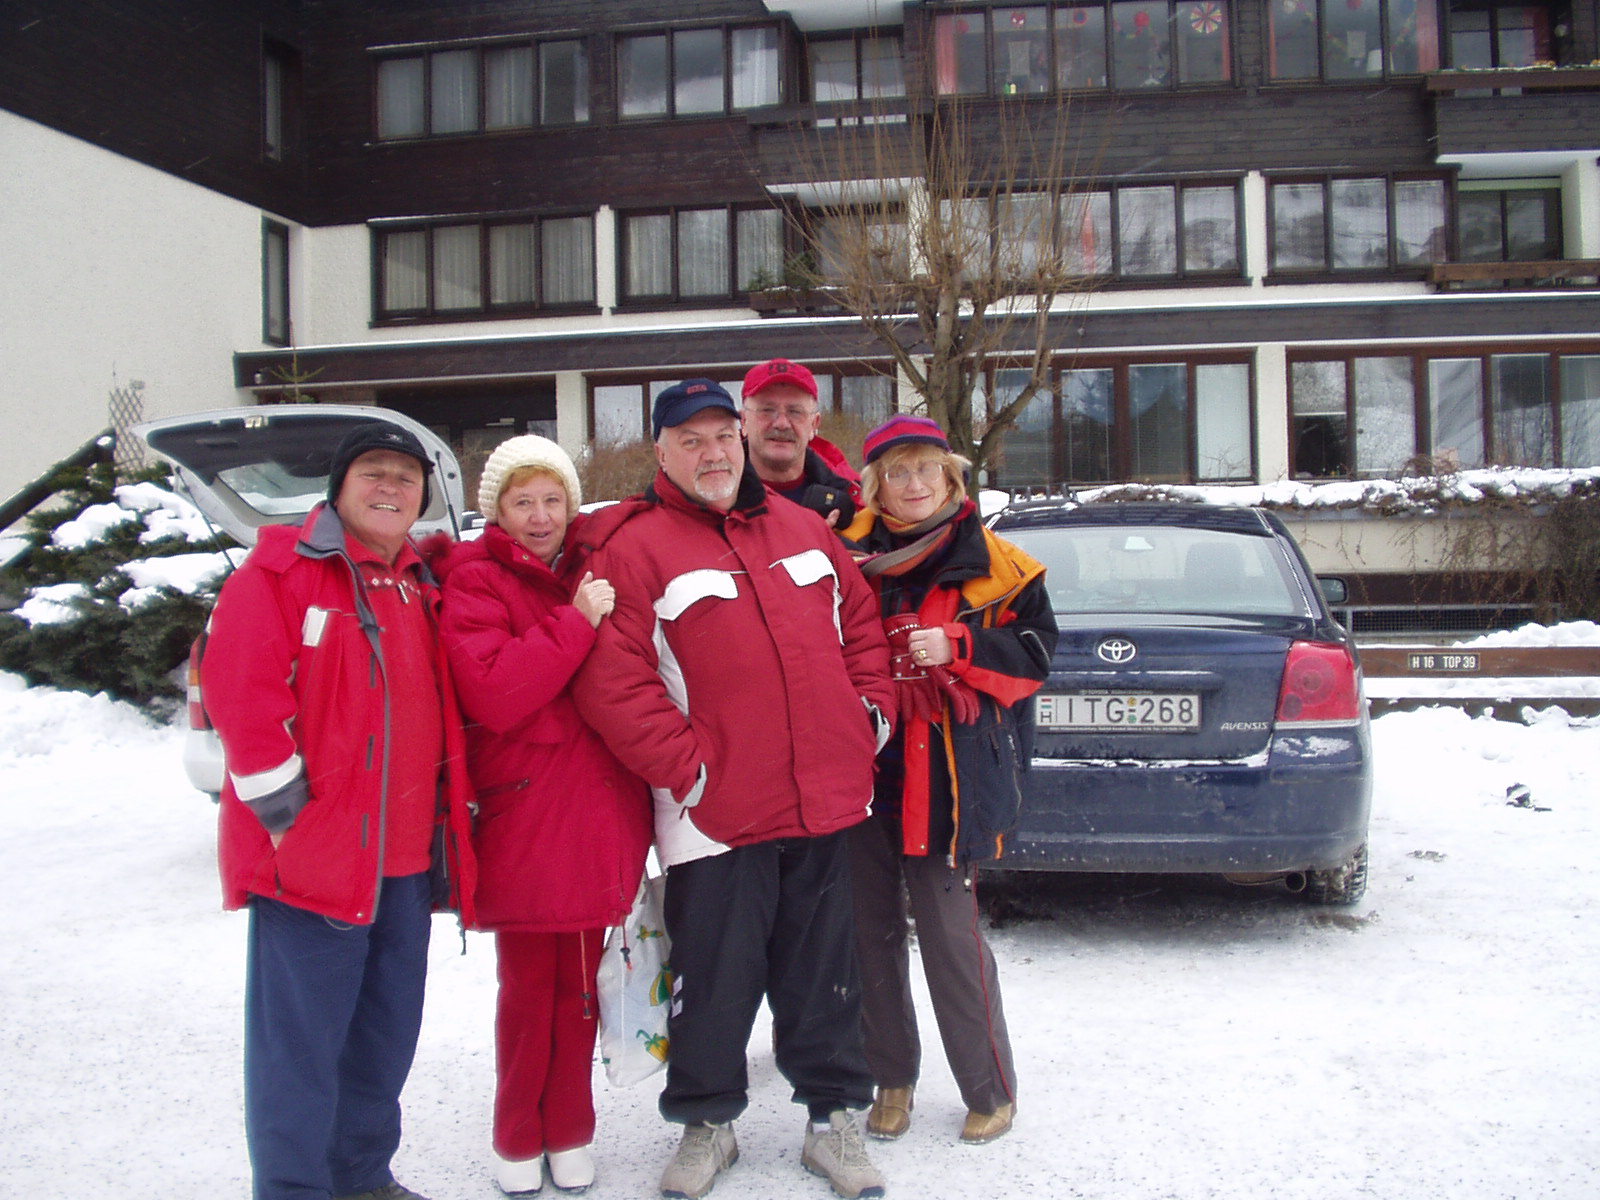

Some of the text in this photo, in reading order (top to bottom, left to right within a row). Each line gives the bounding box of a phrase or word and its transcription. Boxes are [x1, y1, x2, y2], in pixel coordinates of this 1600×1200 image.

[1412, 656, 1420, 669] H
[1442, 656, 1461, 669] TOP
[1462, 656, 1476, 669] 39
[1040, 711, 1052, 723] H
[1220, 721, 1269, 731] AVENSIS
